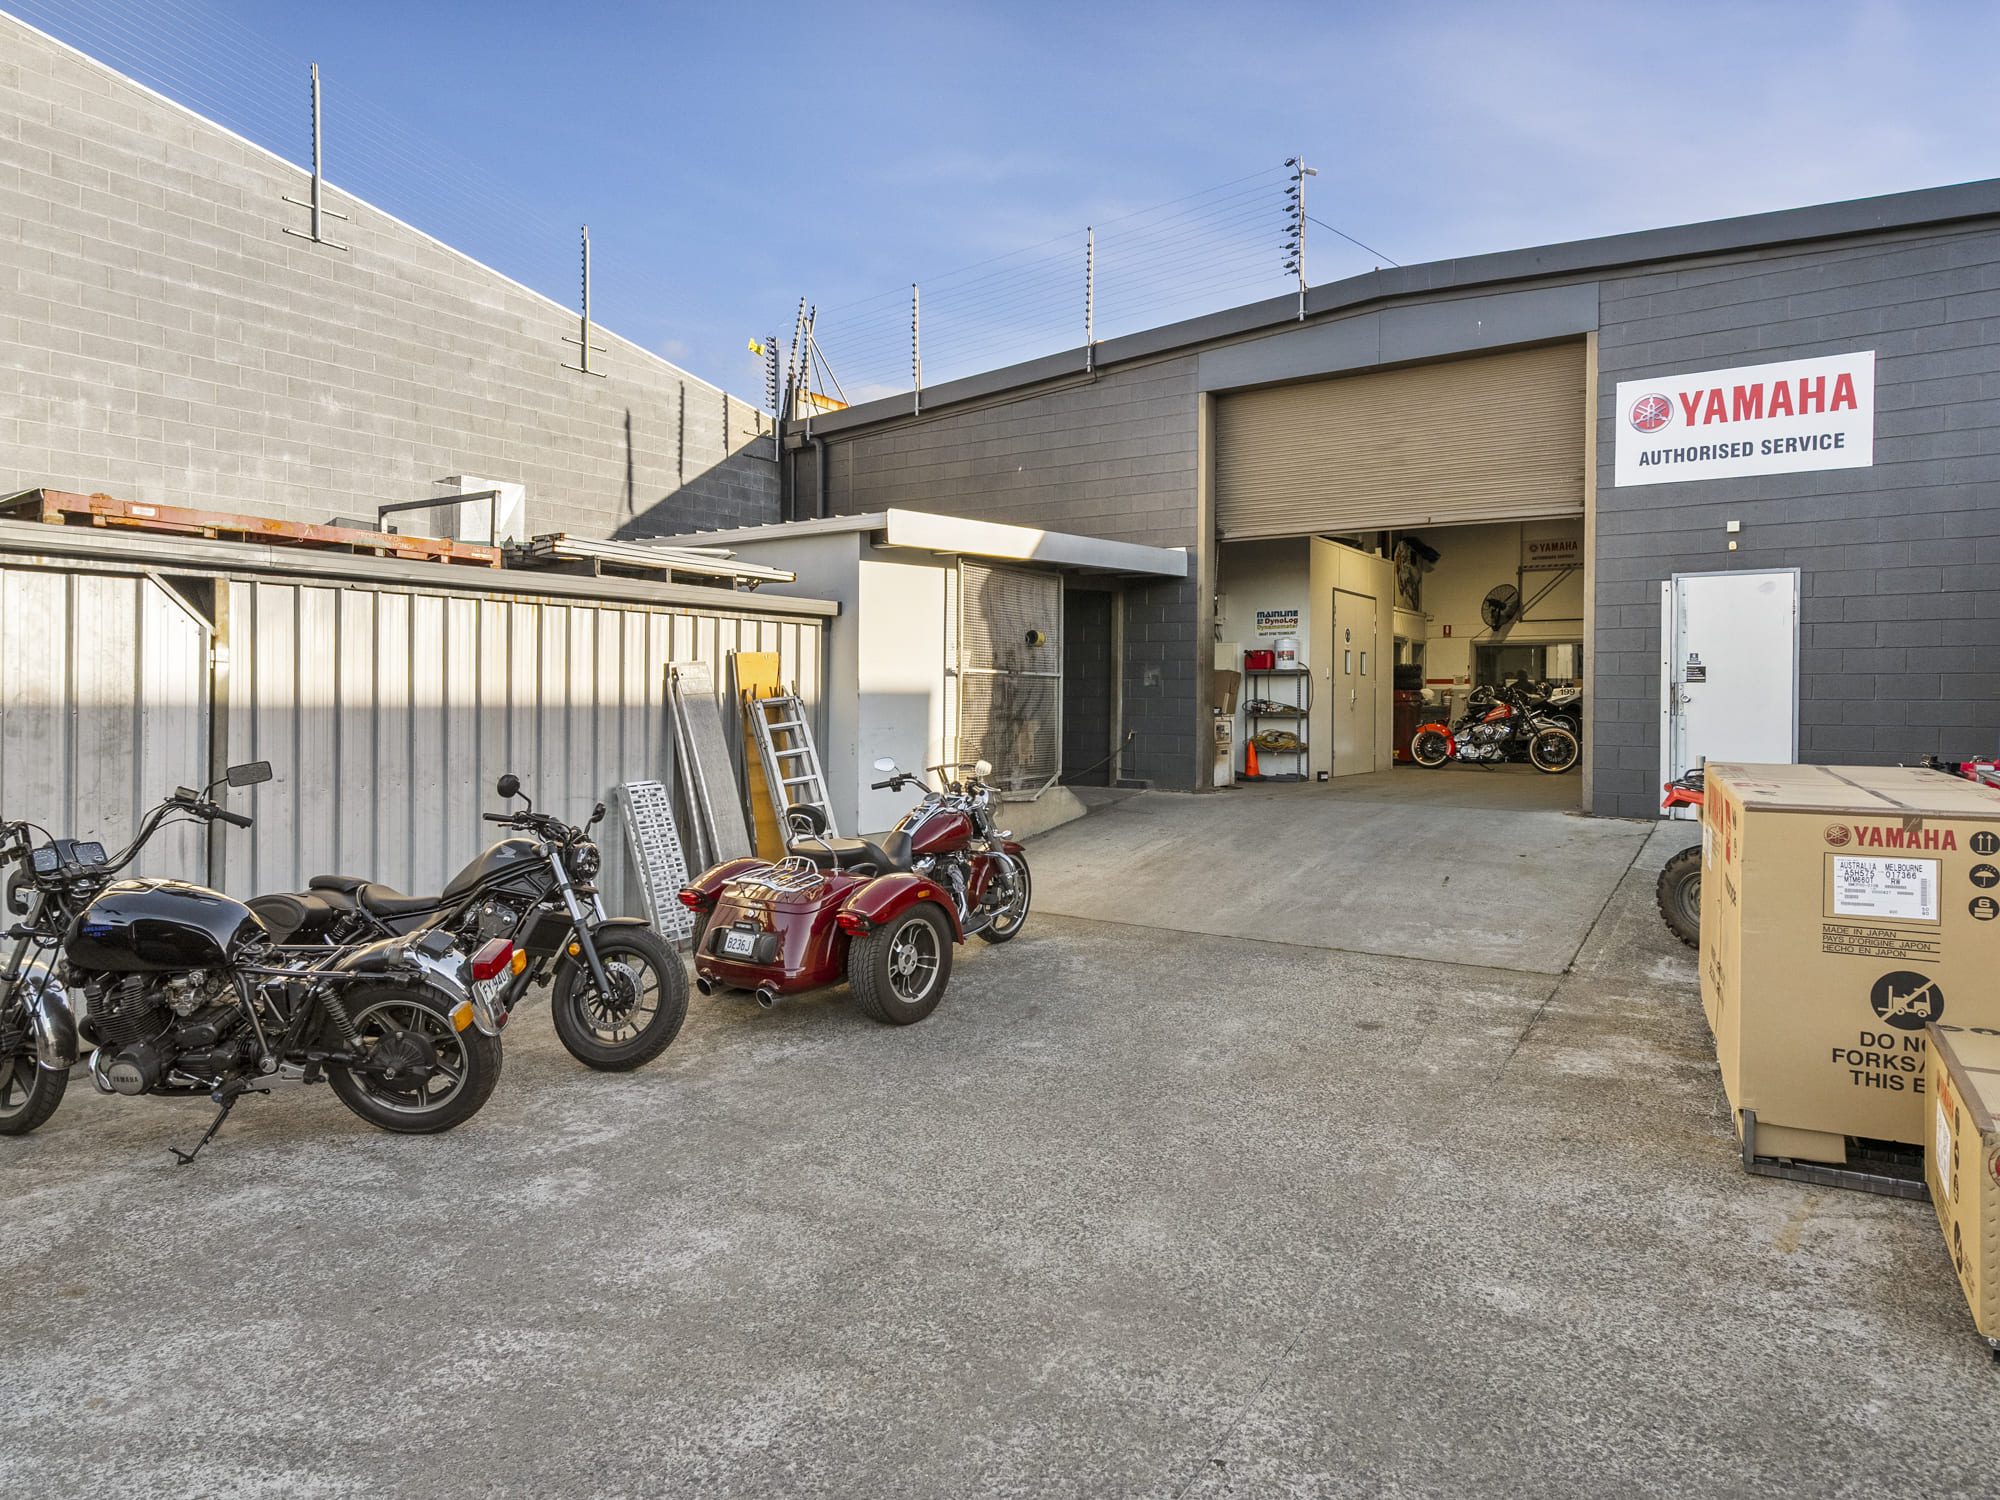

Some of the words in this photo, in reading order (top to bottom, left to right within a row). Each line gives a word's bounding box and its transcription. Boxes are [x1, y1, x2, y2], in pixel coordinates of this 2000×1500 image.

[1679, 373, 1857, 427] YAMAHA
[1639, 440, 1754, 466] AUTHORISED
[1761, 432, 1845, 456] SERVICE
[1539, 540, 1578, 552] YAMAHA
[1257, 610, 1298, 618] MAINLINE
[1265, 617, 1298, 625] DynoLog
[1560, 688, 1576, 696] 199
[1853, 825, 1957, 851] YAMAHA
[1840, 861, 1877, 871] AUSTRALIA
[1884, 863, 1923, 873] MELBOURNE
[1822, 925, 1849, 935] MADE
[1853, 928, 1863, 936] IN
[1867, 929, 1897, 938] JAPAN
[727, 937, 752, 952] B236J
[1822, 935, 1845, 943] PAYS
[1848, 936, 1895, 947] D'ORIGINE
[1899, 942, 1931, 951] JAPON
[1822, 943, 1855, 953] HECHO
[1858, 946, 1872, 954] EN
[1860, 1031, 1896, 1050] DO
[1903, 1036, 1925, 1053] N
[1848, 1069, 1905, 1091] THIS
